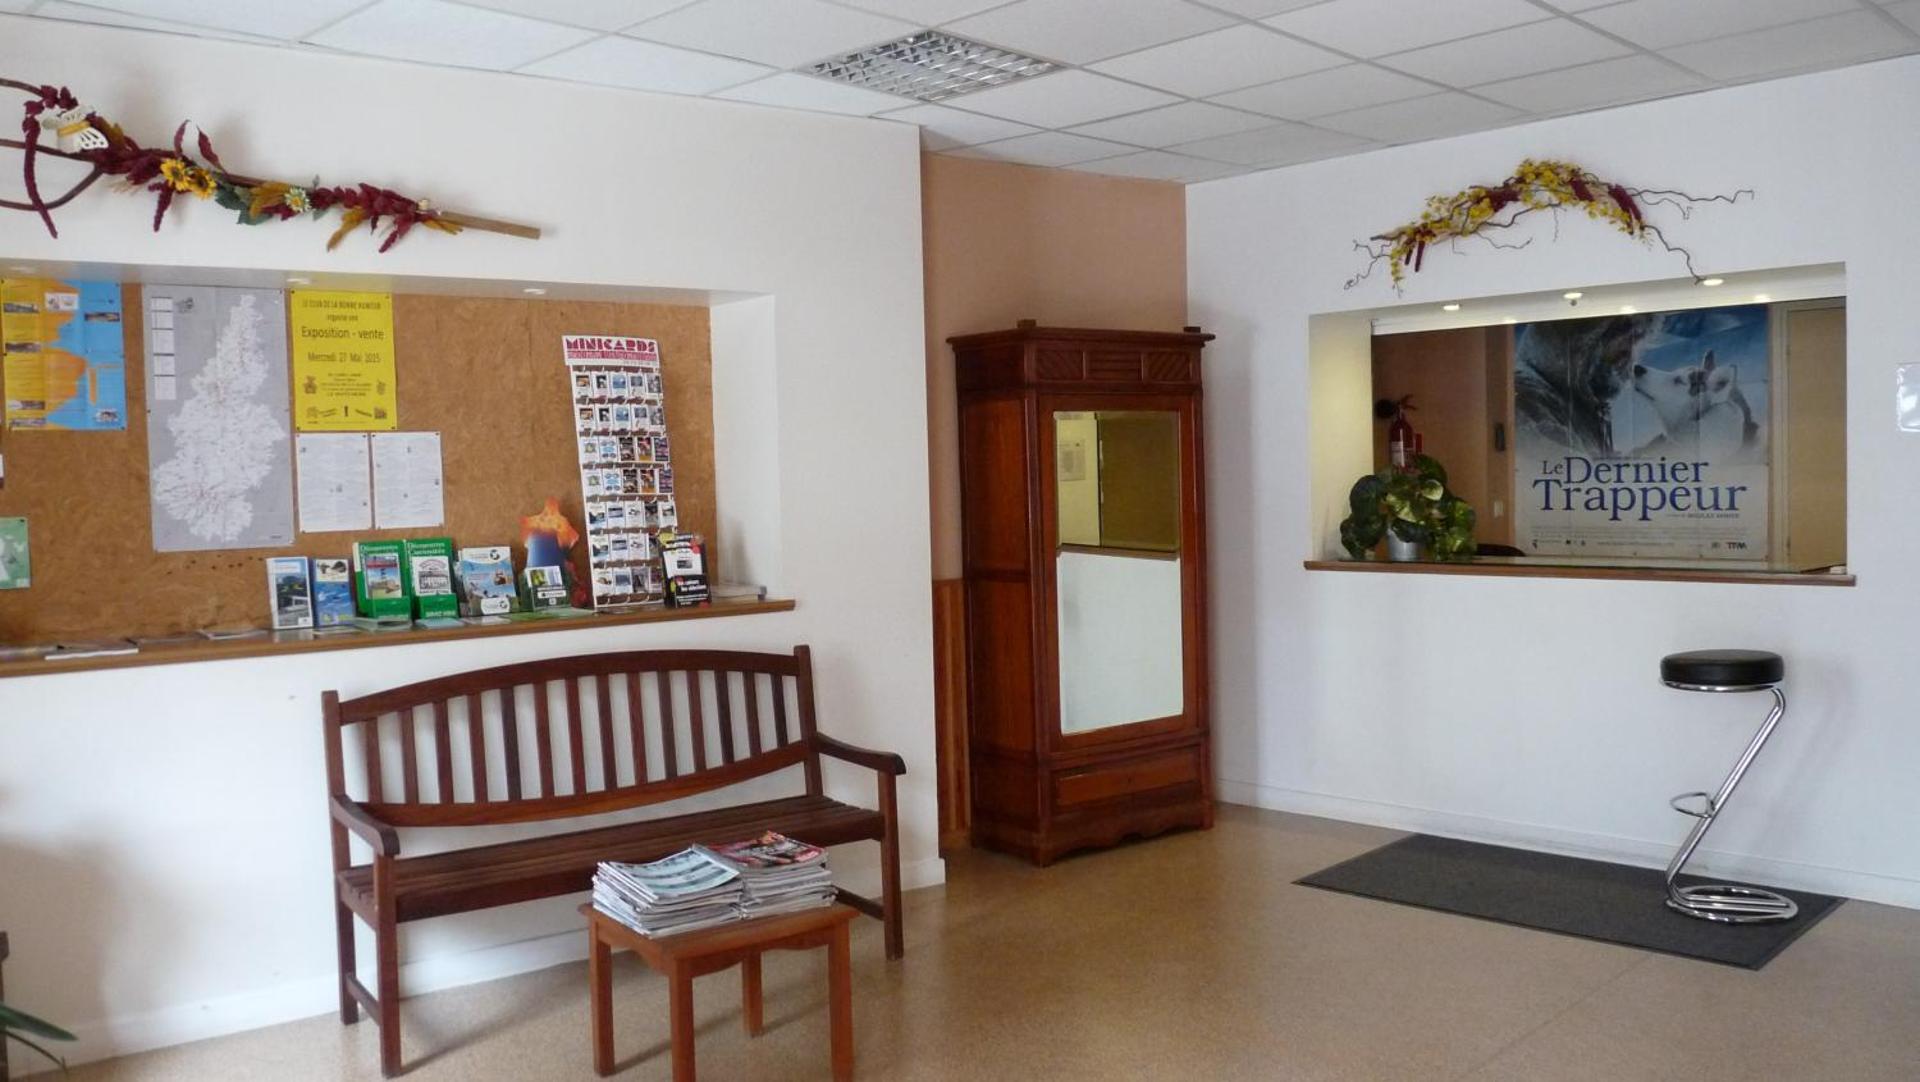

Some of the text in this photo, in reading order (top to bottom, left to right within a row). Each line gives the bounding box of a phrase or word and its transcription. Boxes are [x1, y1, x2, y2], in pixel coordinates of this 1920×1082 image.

[301, 326, 350, 340] Exposition
[358, 328, 385, 340] vente
[566, 338, 655, 352] MINICARDS
[1542, 456, 1709, 484] Le Dernier
[1532, 478, 1747, 521] Trappeur
